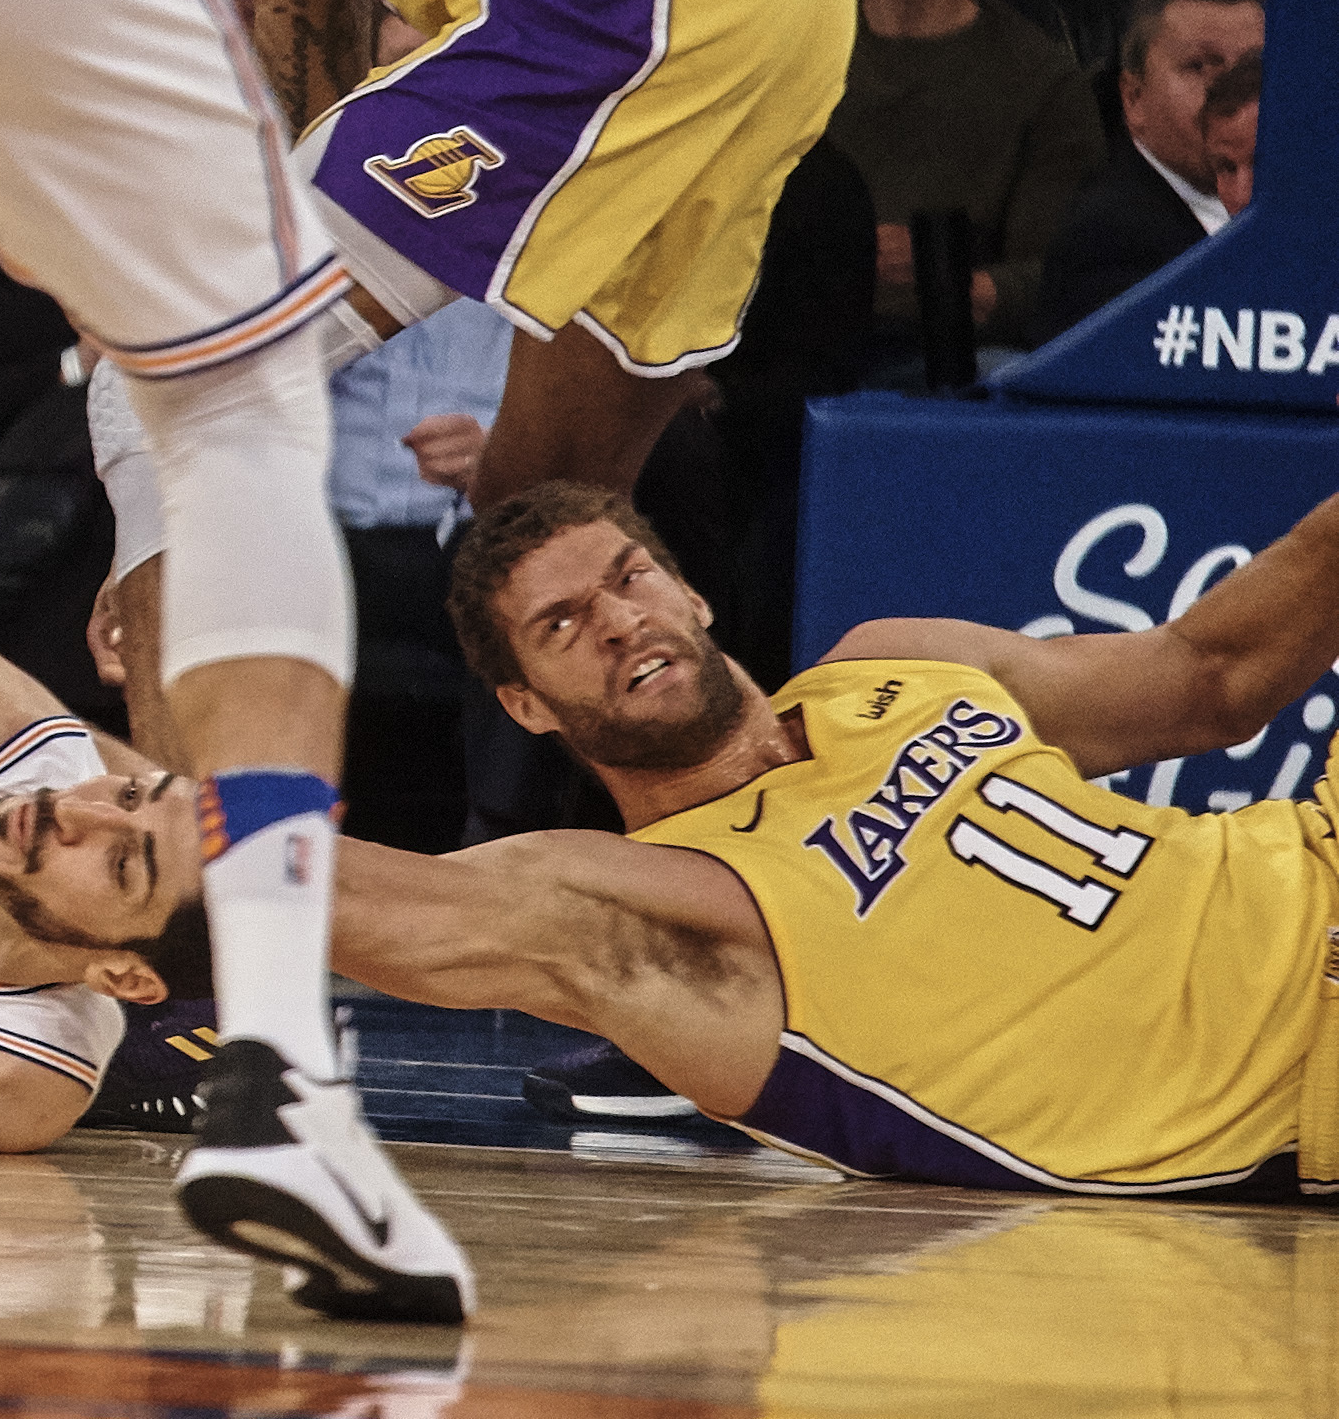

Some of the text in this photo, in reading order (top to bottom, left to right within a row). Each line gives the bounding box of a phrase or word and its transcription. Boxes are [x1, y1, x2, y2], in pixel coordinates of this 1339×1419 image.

[857, 678, 904, 721] wish
[801, 696, 1025, 924] LAKERS
[944, 771, 1156, 933] 11
